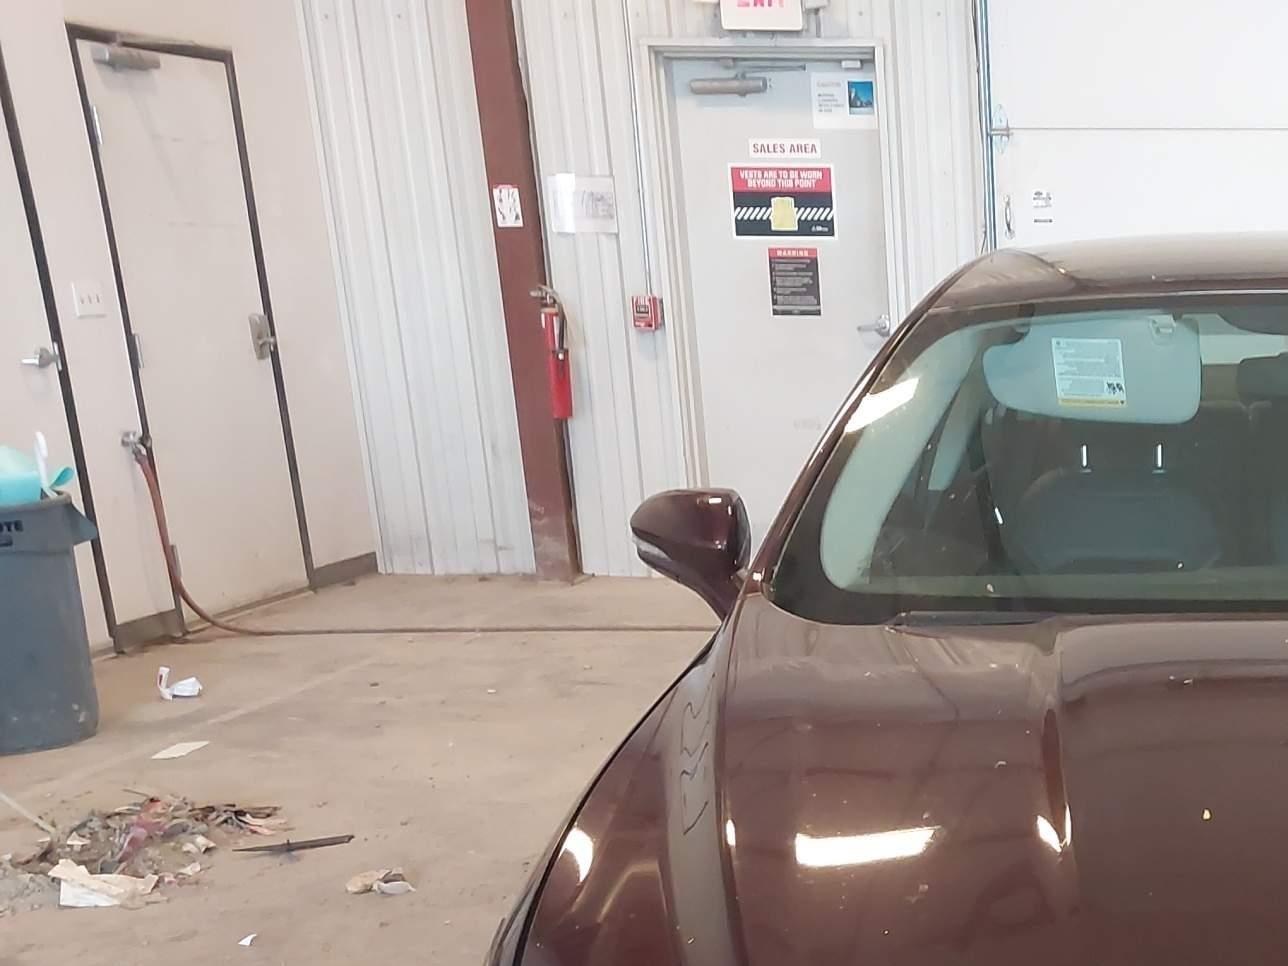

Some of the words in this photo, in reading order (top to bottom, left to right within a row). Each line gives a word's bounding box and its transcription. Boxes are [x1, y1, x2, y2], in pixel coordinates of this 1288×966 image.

[752, 143, 785, 153] SALES
[789, 143, 817, 154] AREA
[778, 170, 788, 179] TO
